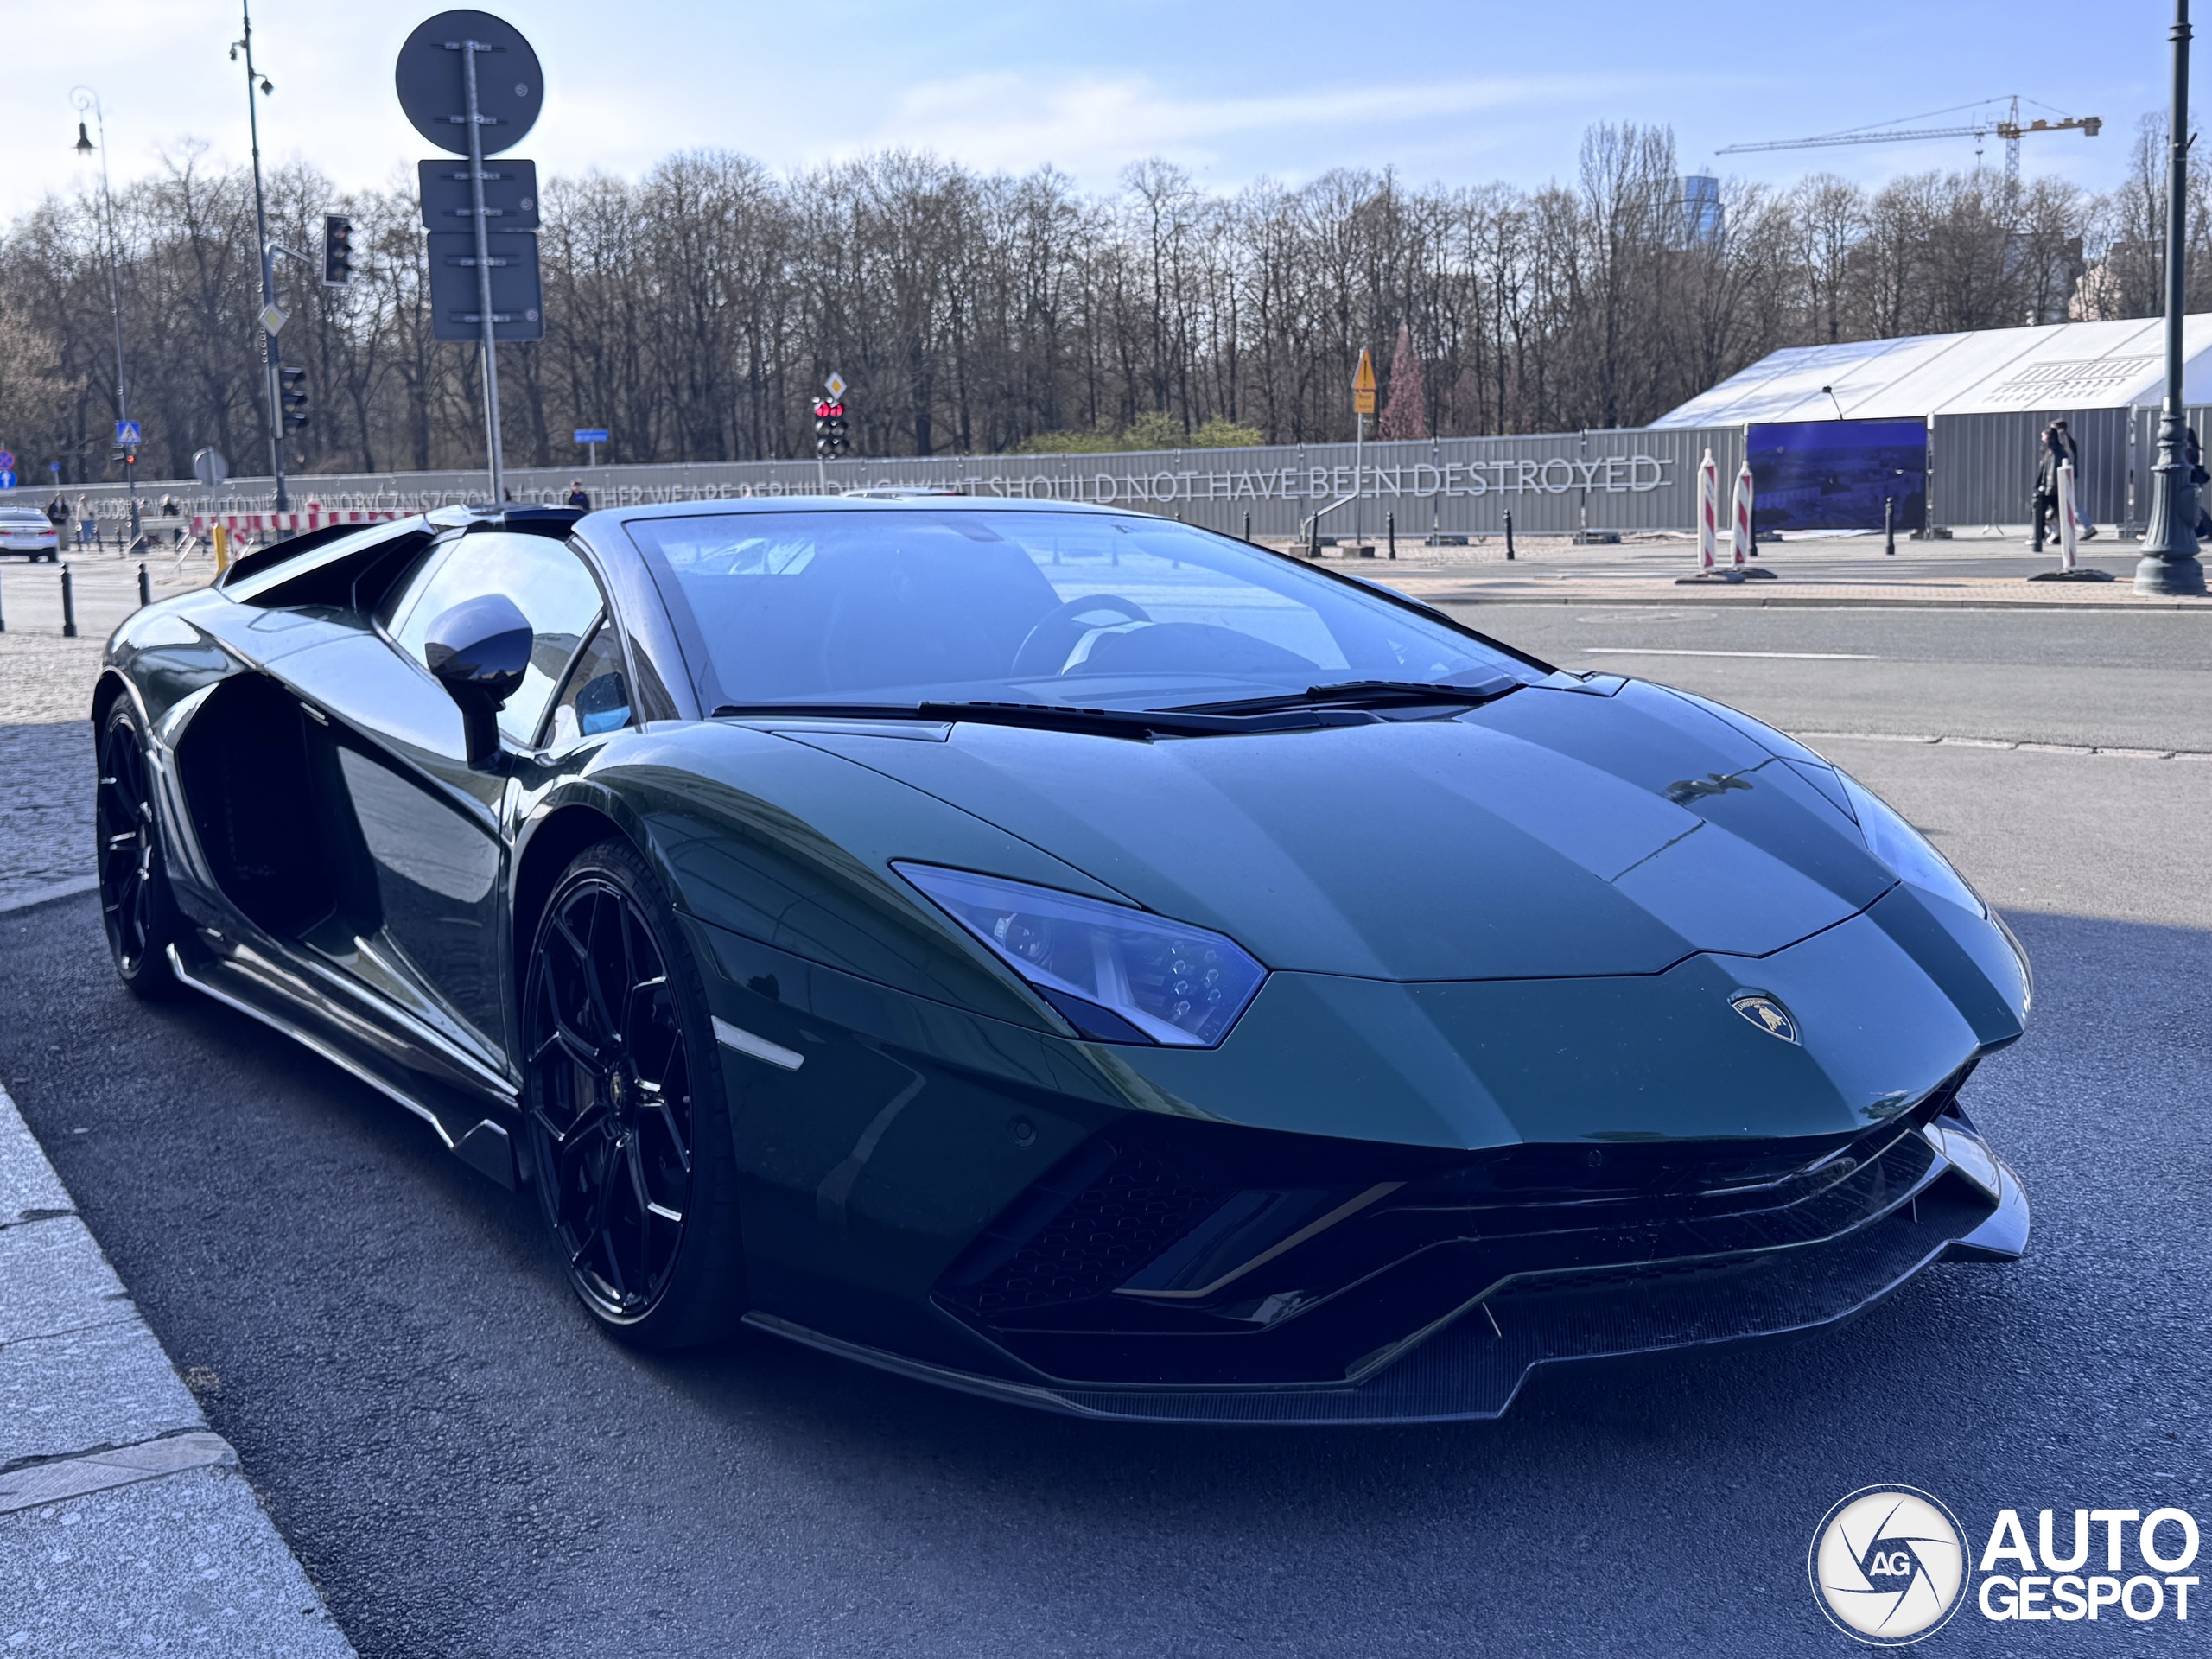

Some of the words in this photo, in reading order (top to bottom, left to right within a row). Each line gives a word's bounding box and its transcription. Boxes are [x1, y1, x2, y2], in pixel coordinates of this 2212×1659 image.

[989, 473, 1117, 504] SHOULD
[1127, 469, 1198, 504] NOT
[1210, 467, 1298, 501] HAVE
[1309, 463, 1402, 499] BEEN
[1414, 454, 1662, 499] DESTROYED
